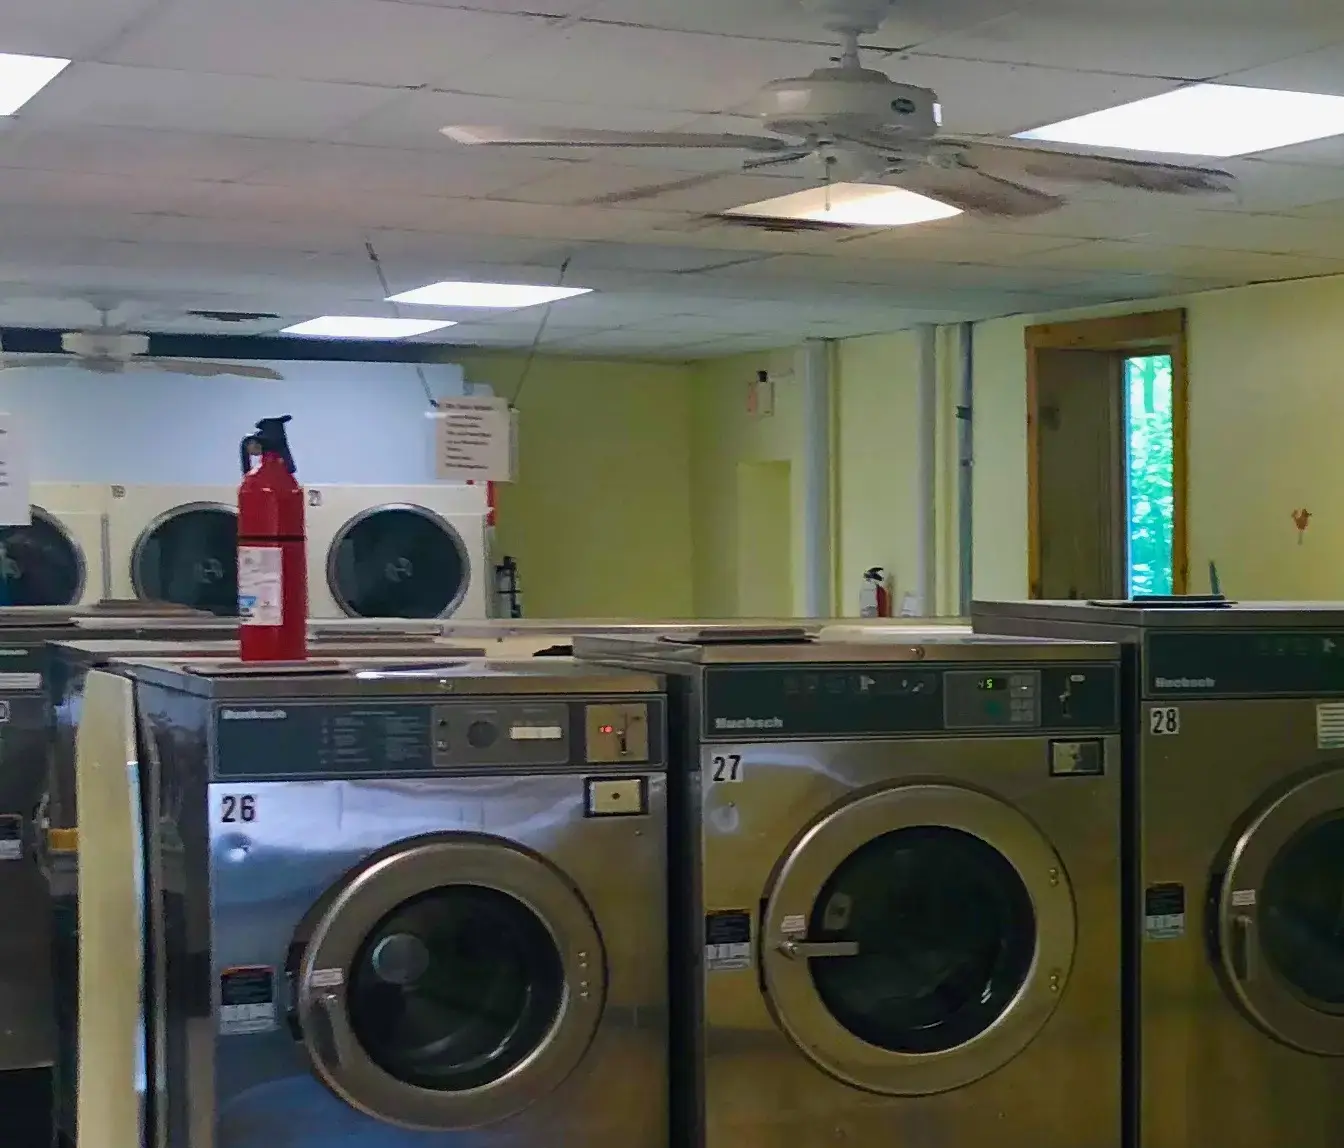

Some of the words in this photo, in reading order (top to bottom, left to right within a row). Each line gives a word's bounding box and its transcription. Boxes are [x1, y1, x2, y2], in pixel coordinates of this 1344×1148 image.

[1152, 708, 1178, 734] 28
[713, 754, 742, 782] 27
[221, 795, 256, 823] 26
